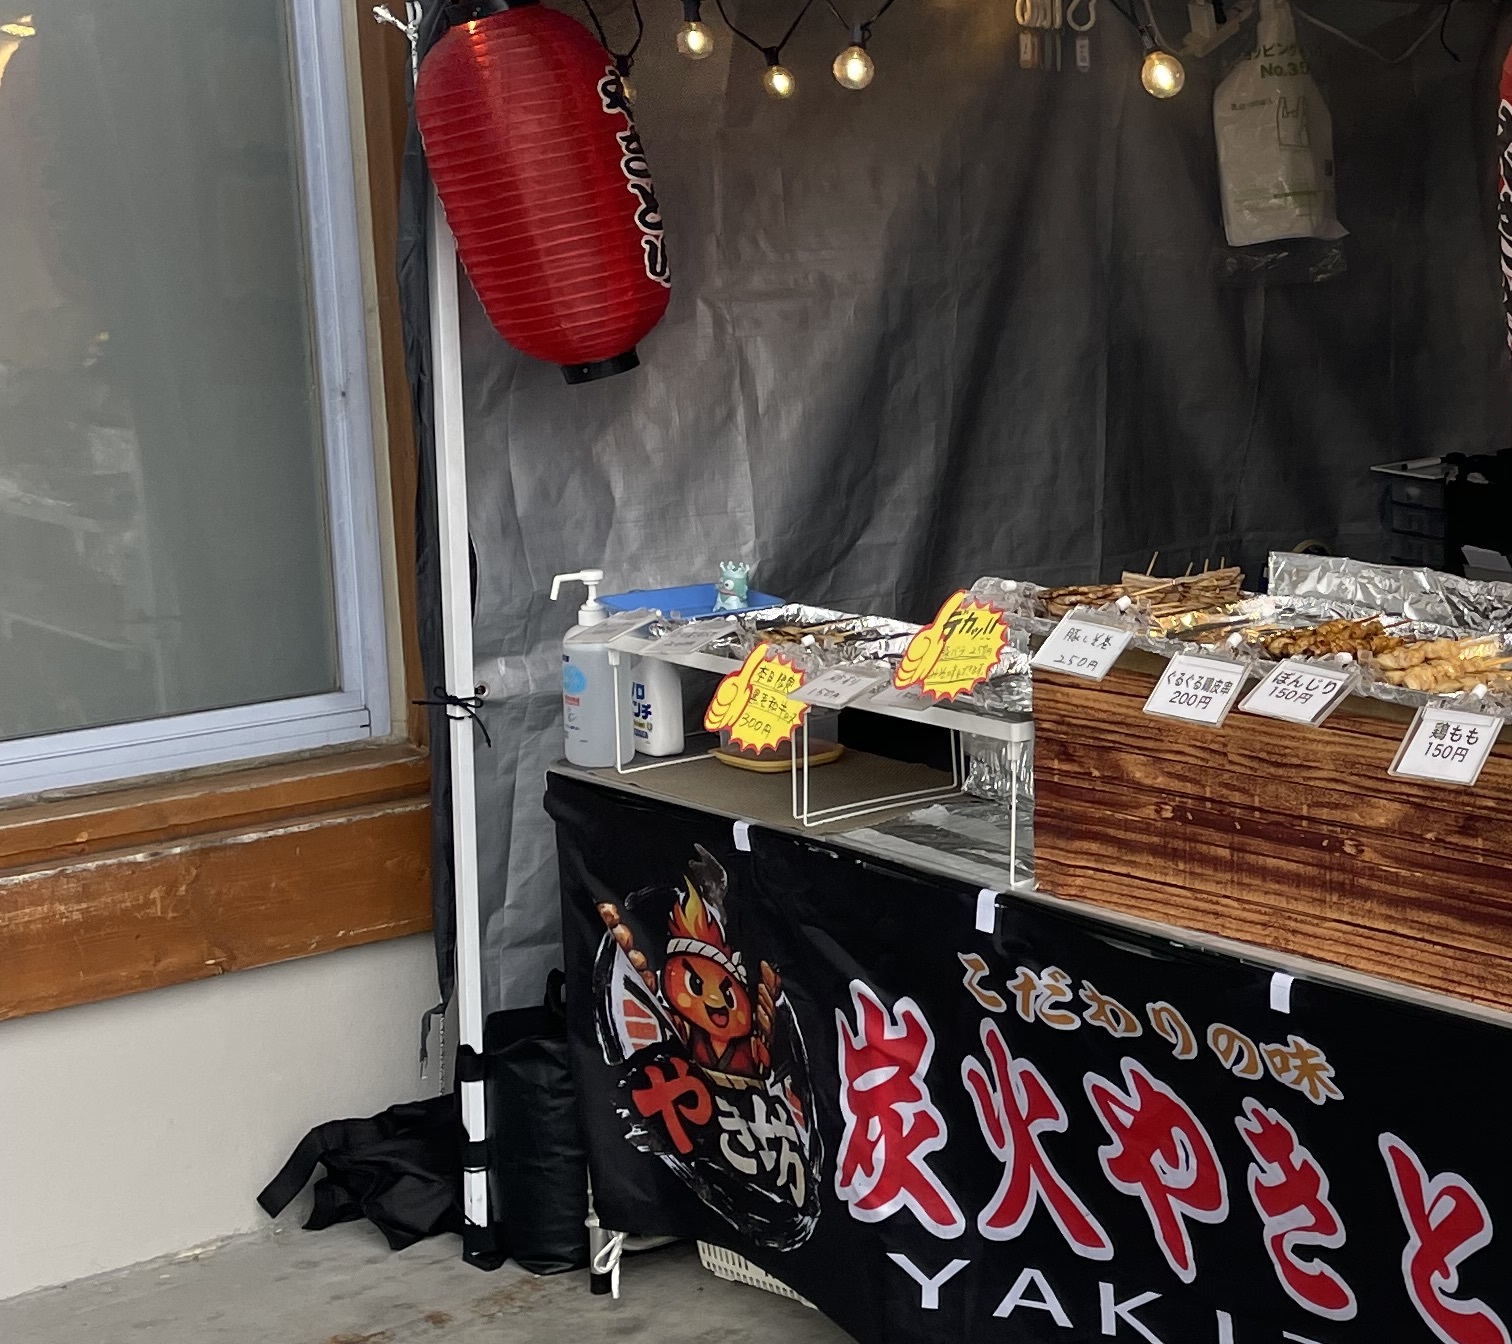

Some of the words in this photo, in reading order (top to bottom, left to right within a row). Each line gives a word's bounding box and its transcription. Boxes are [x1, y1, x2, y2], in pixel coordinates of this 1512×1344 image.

[1053, 654, 1099, 671] 250円
[1168, 691, 1212, 710] 200円
[1268, 686, 1314, 704] 150円
[738, 713, 772, 738] 300円
[1428, 721, 1479, 745] 鶏もも
[1424, 742, 1469, 763] 150円
[957, 951, 1344, 1105] こだわりの味
[632, 1057, 806, 1208] やき坊
